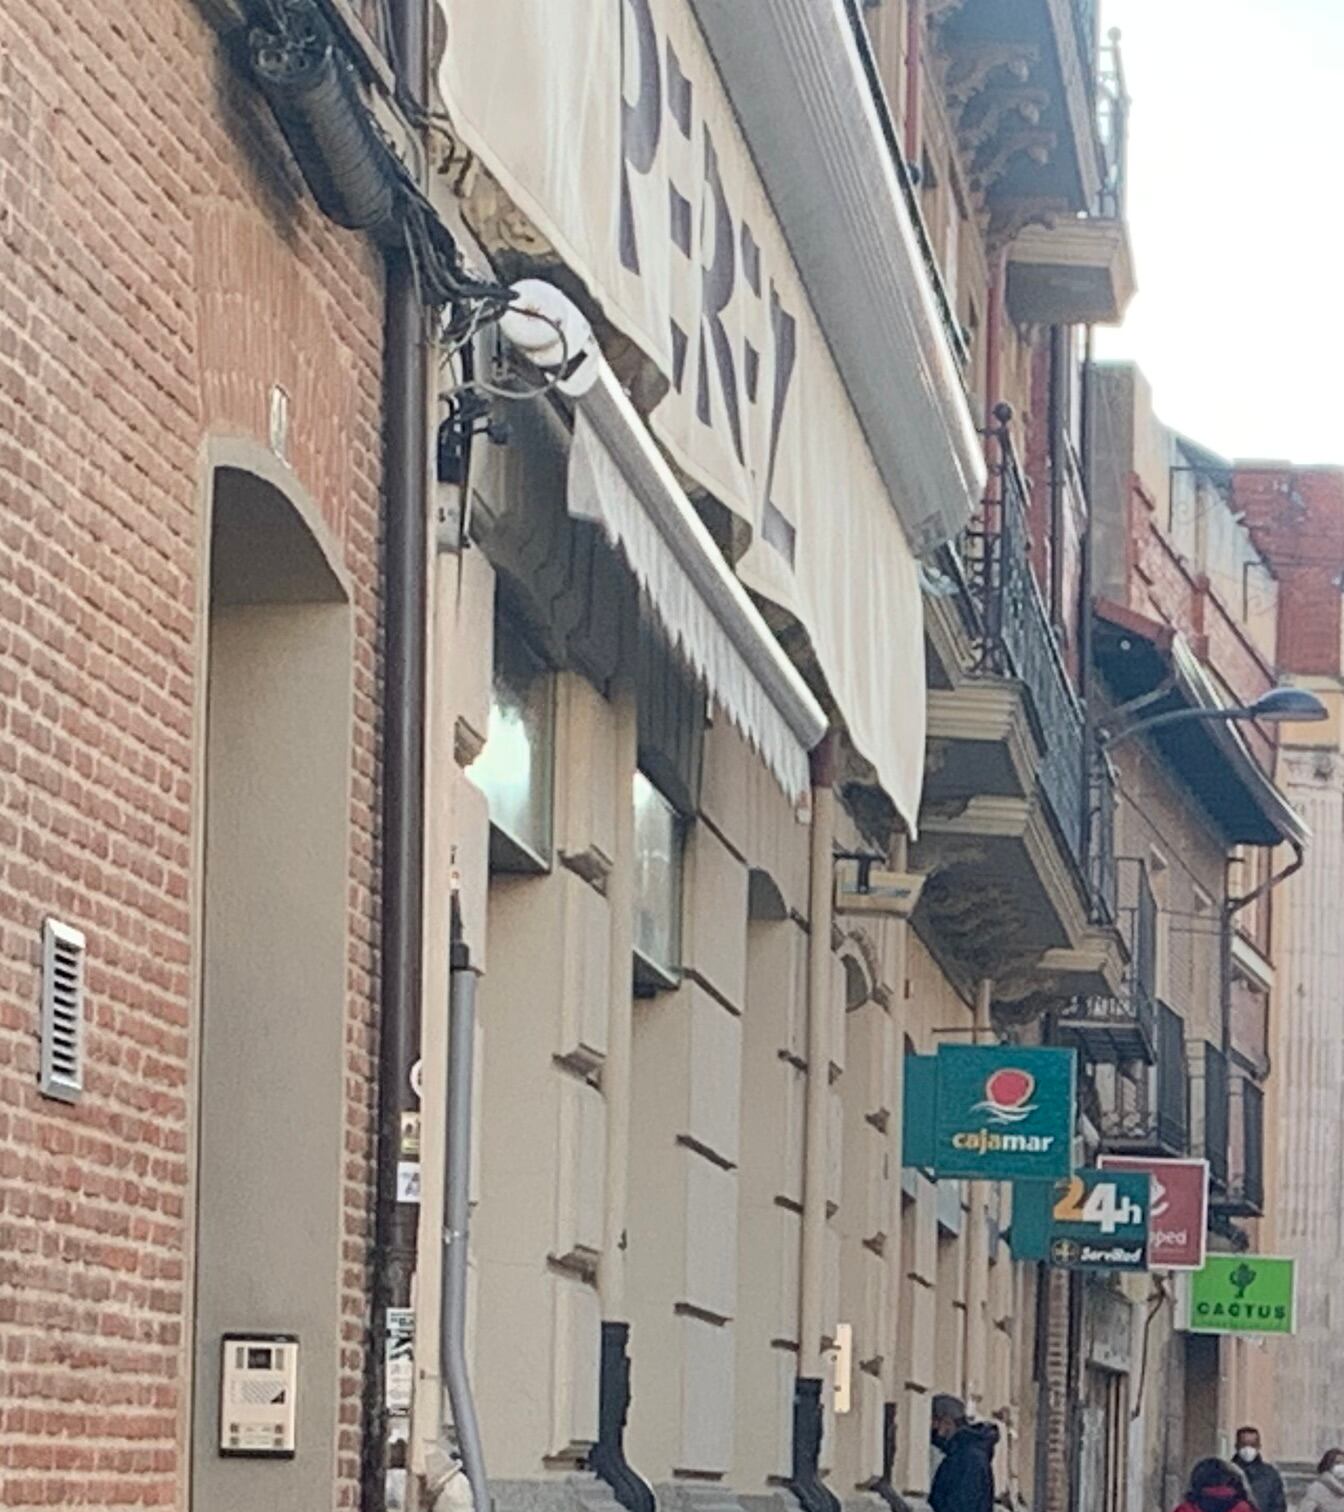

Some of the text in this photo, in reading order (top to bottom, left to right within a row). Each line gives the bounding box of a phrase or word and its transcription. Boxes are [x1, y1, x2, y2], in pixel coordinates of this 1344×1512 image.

[952, 1128, 1055, 1155] cajamar
[1053, 1175, 1143, 1233] 24h
[1196, 1302, 1286, 1320] CACTUS
